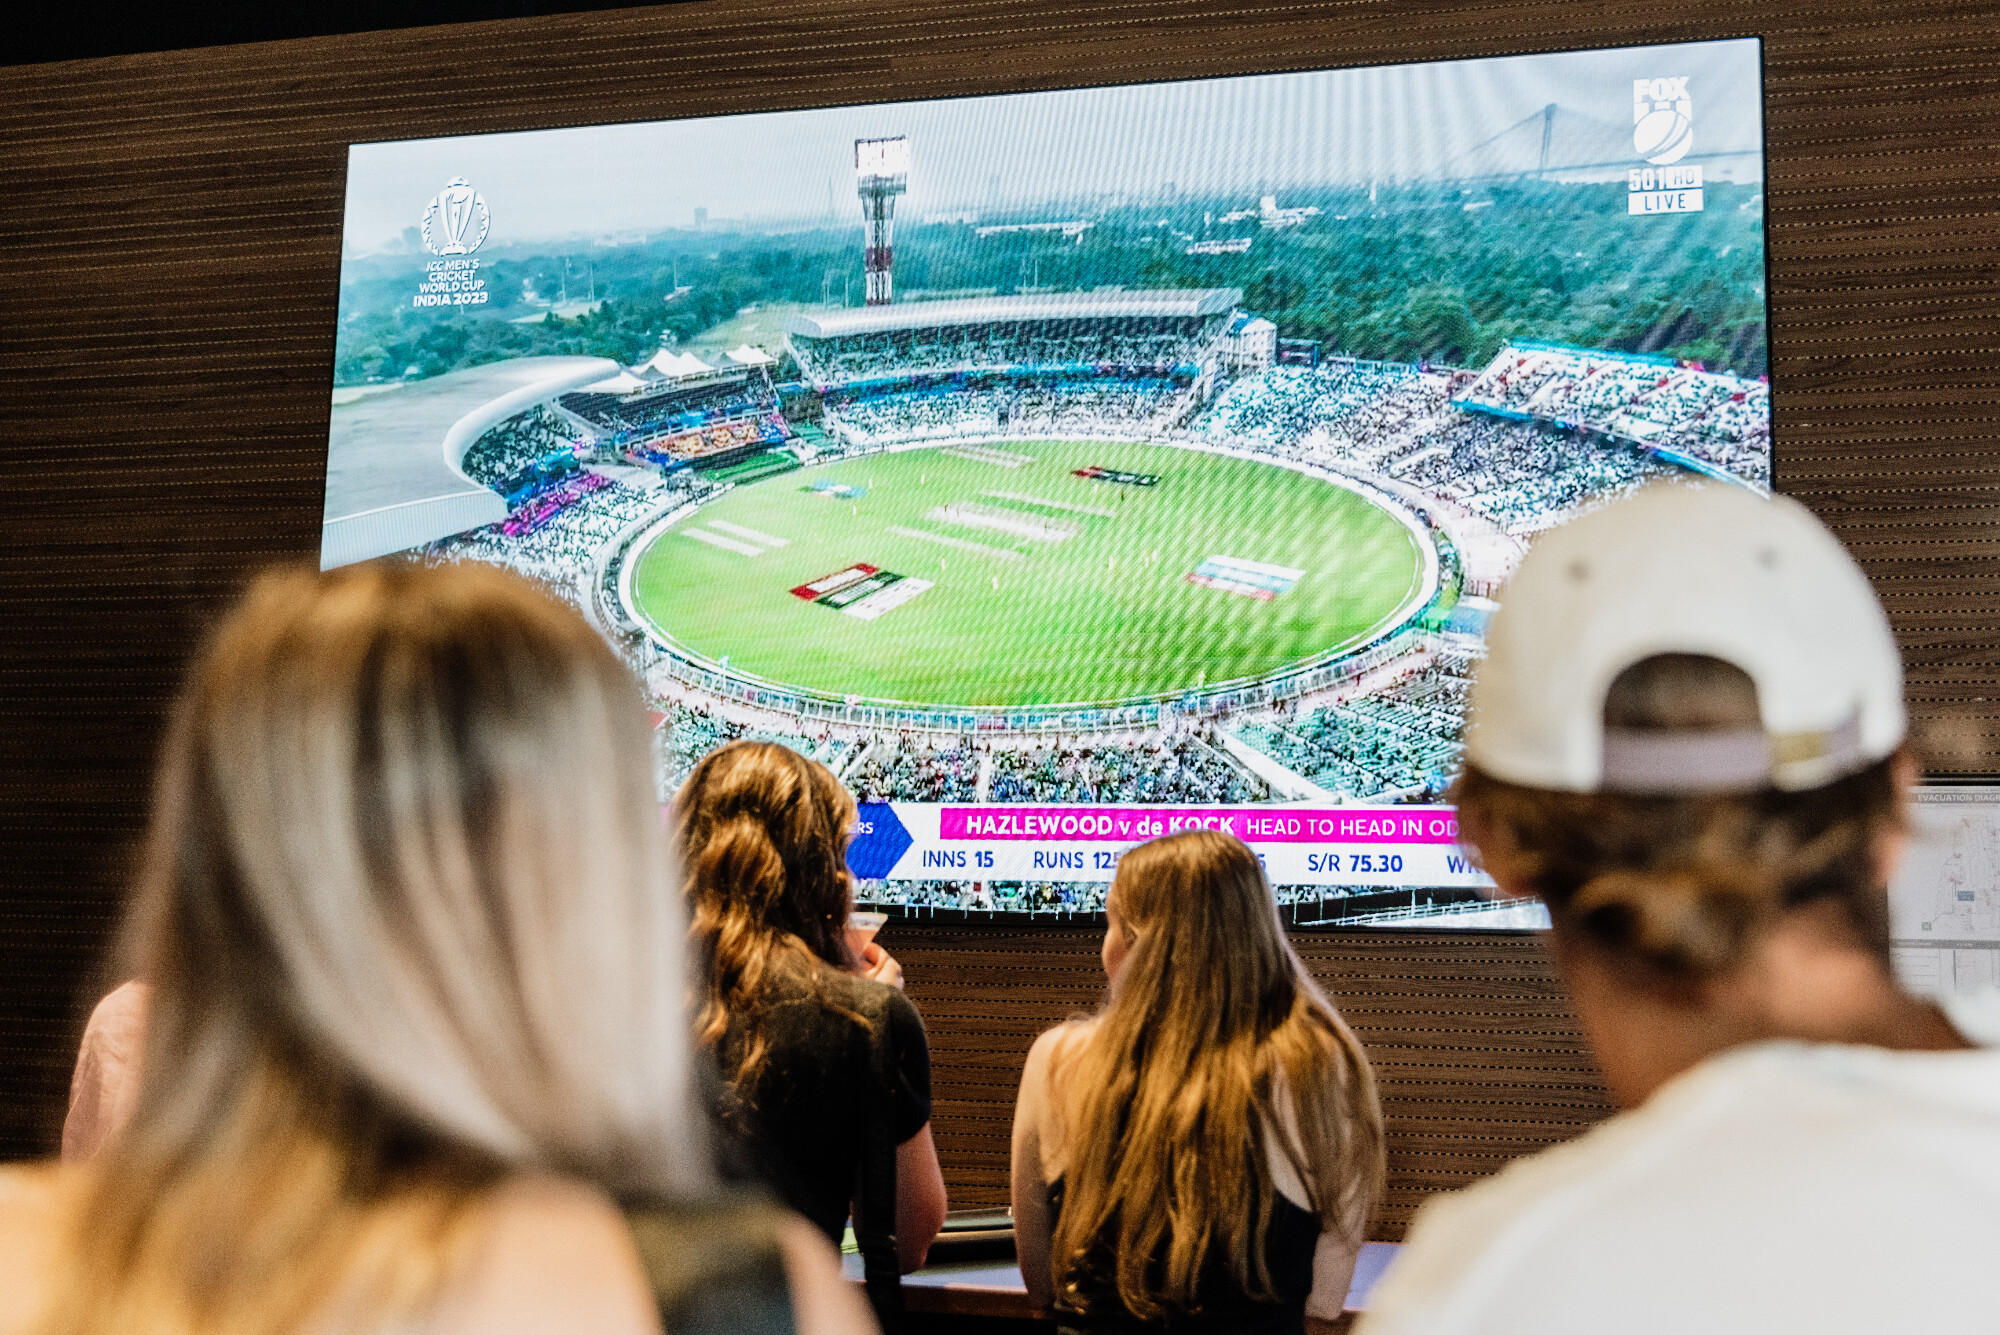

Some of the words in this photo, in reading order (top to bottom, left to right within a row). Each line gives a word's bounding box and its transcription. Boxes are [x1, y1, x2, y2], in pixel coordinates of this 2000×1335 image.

[1633, 76, 1691, 103] FOX
[1628, 167, 1665, 191] 501
[1644, 193, 1686, 211] LIVE
[426, 261, 444, 272] ICC
[445, 259, 480, 271] MEN'S
[429, 270, 476, 282] CRICKET
[419, 282, 460, 294] WORLD
[461, 280, 485, 291] CUP
[413, 294, 452, 307] INDIA
[453, 291, 488, 305] 2023
[1917, 794, 1972, 802] EVACUATION
[966, 815, 1113, 835] HAZLEWOOD
[1118, 820, 1131, 835] v
[1137, 815, 1163, 836] de
[1169, 816, 1234, 835] KOCK
[1247, 818, 1300, 836] HEAD
[1306, 818, 1334, 836] TO
[1340, 818, 1396, 836] HEAD
[1402, 819, 1422, 836] IN
[922, 850, 966, 867] INNS
[974, 851, 994, 868] 15
[1033, 851, 1084, 868] RUNS
[1308, 853, 1341, 873] S/R
[1350, 854, 1403, 873] 75.30
